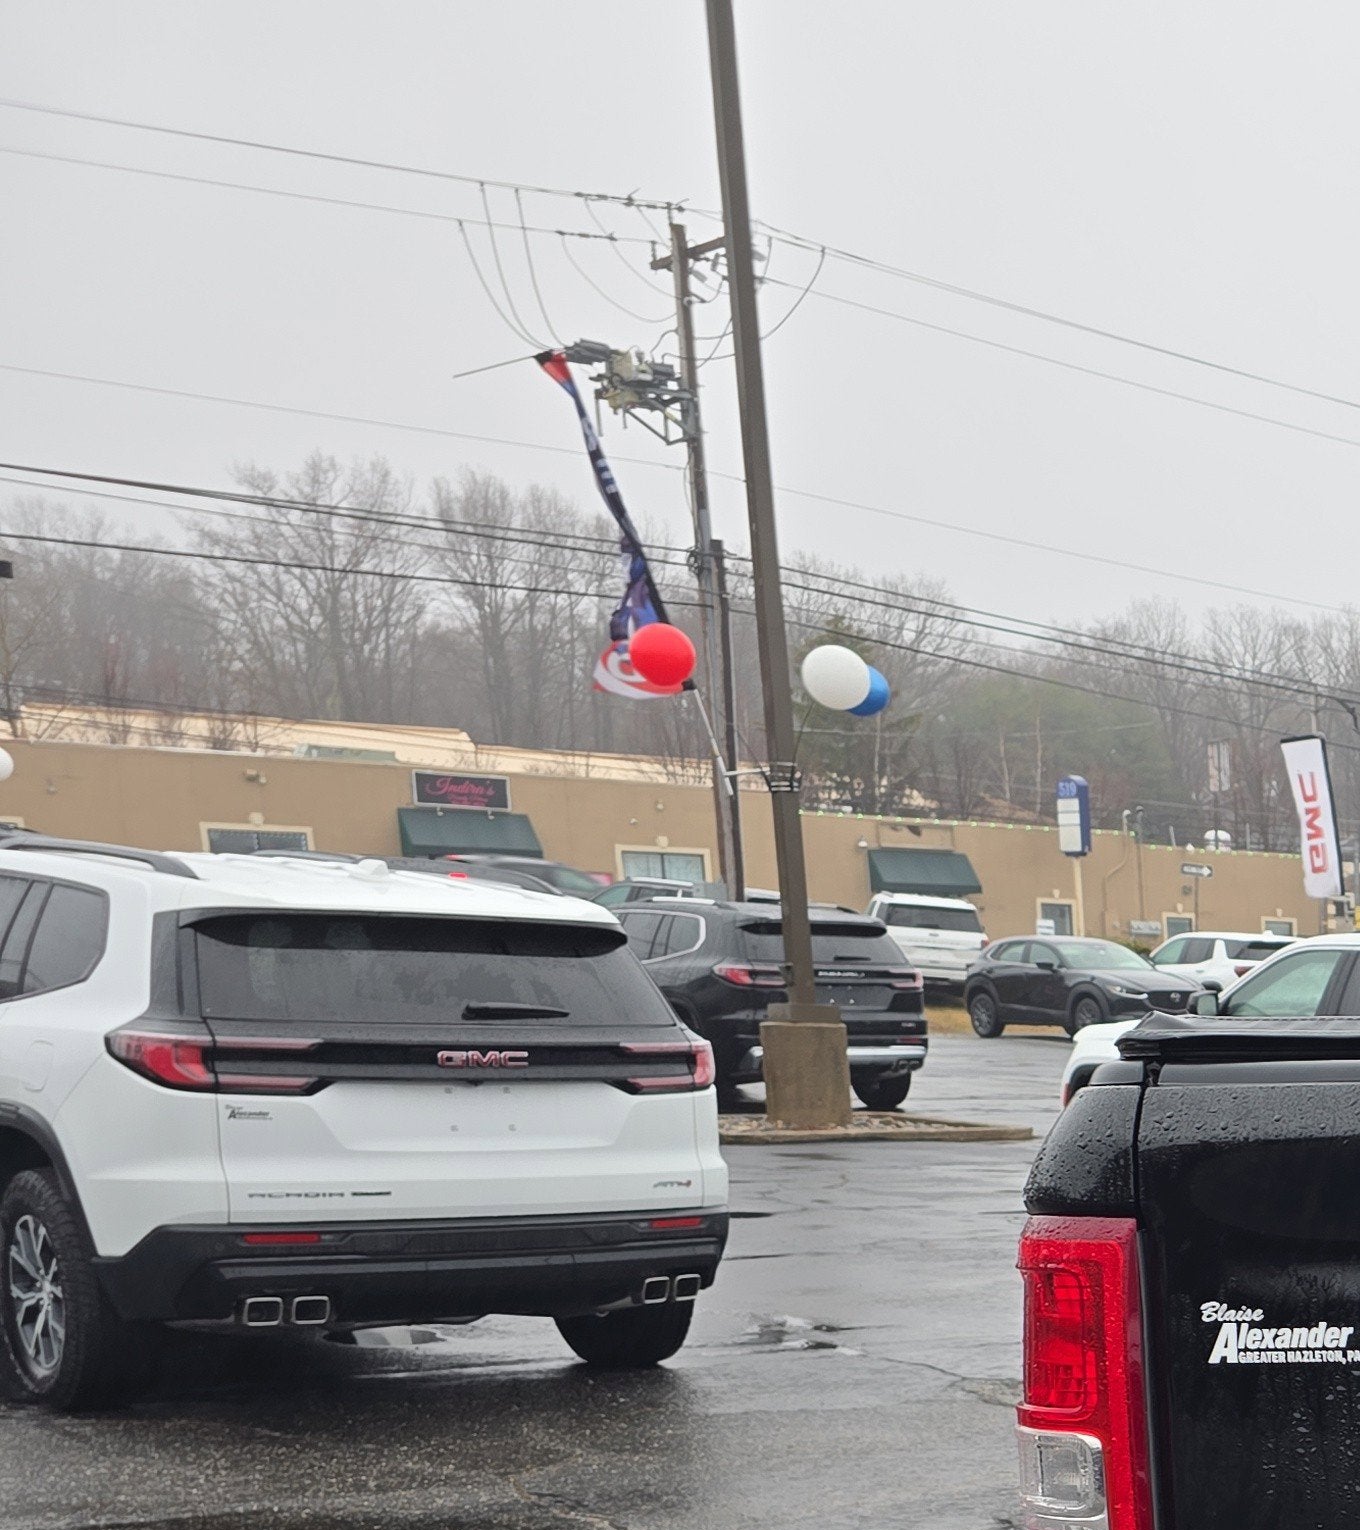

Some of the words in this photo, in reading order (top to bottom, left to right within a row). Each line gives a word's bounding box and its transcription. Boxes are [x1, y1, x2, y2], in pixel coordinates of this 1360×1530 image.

[1297, 770, 1329, 874] GMC
[437, 1050, 529, 1068] GMC
[1200, 1301, 1264, 1322] Blaise
[1208, 1321, 1354, 1364] Alexander
[1238, 1351, 1286, 1364] GREATER
[1287, 1350, 1346, 1364] HAZLETON,
